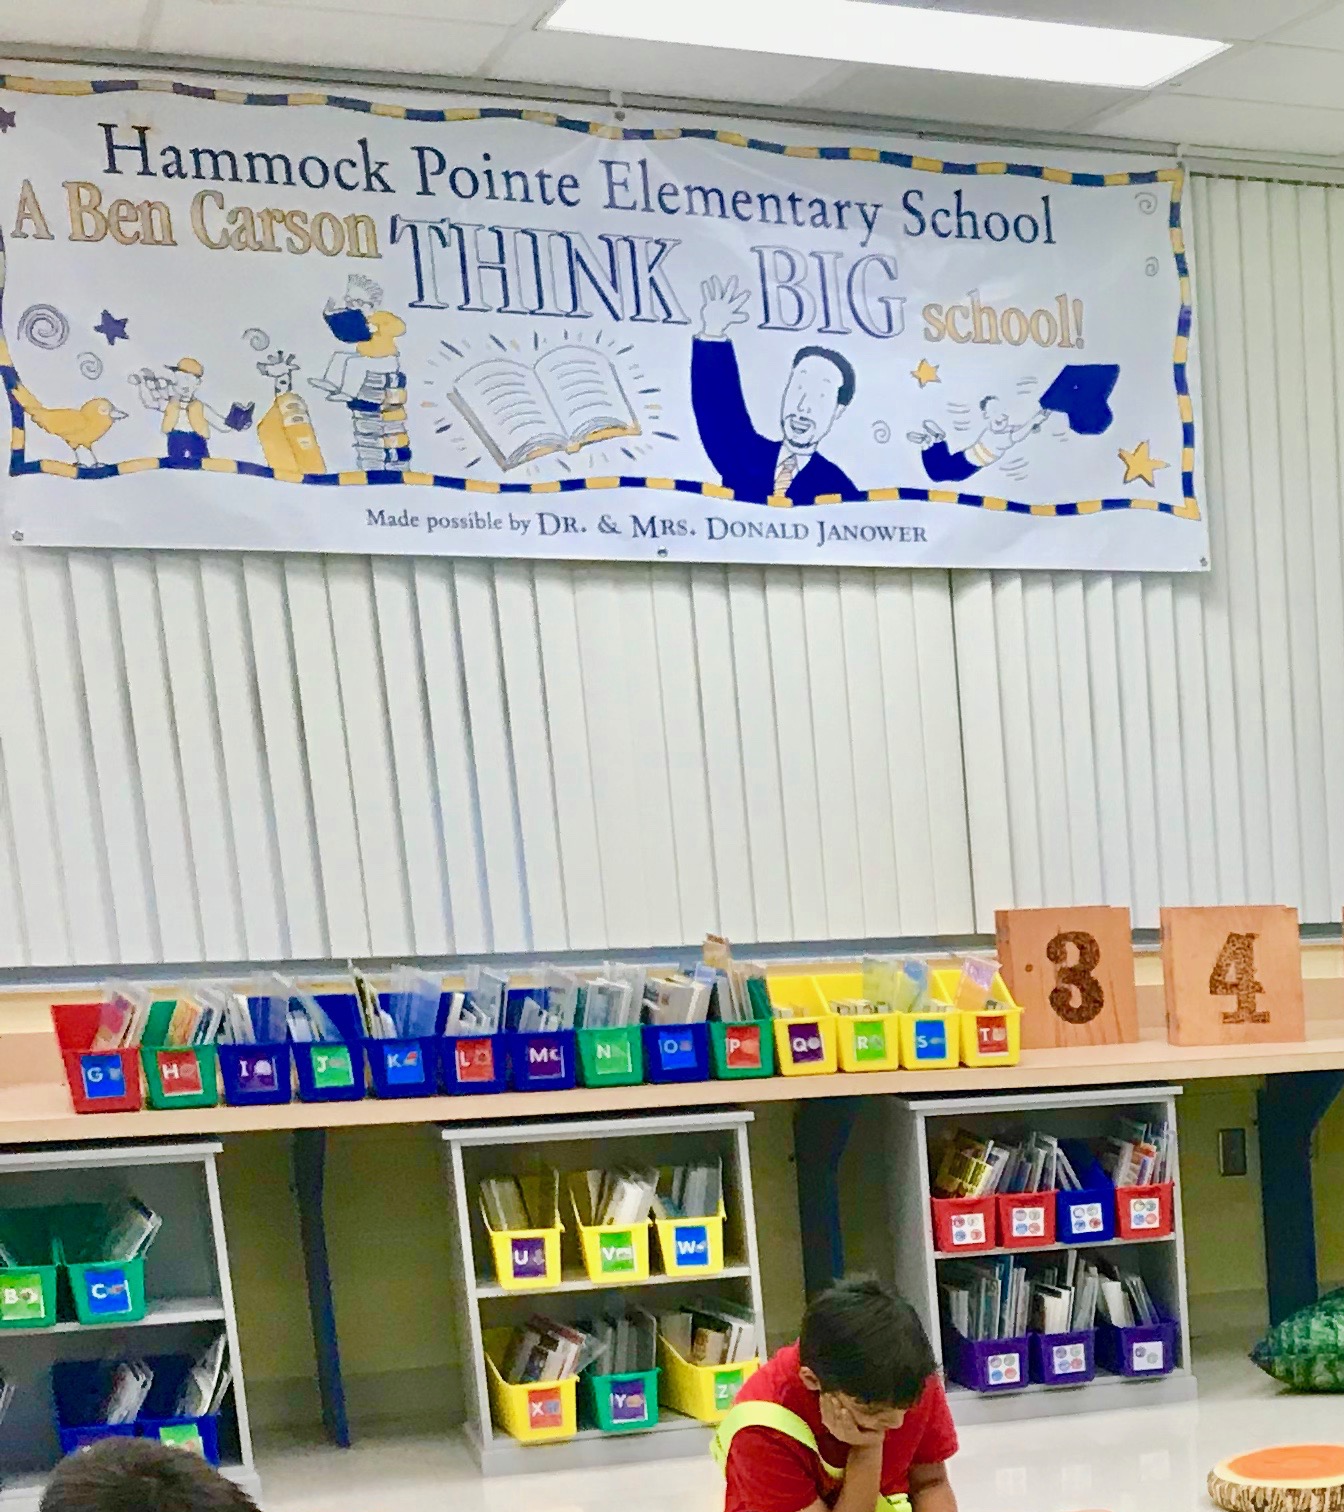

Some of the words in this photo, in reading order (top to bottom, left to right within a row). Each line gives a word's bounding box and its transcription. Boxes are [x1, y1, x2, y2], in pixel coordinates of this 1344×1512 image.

[98, 121, 397, 195] Hammock
[410, 145, 581, 208] Pointe
[599, 158, 883, 247] Elementary
[902, 188, 1057, 246] School
[10, 179, 54, 242] A
[62, 179, 178, 249] Ben
[189, 188, 382, 260] Carson
[390, 214, 693, 327] THINK
[750, 244, 907, 340] BIG
[922, 289, 1086, 350] school!
[365, 508, 420, 532] Made
[426, 509, 503, 535] possible
[509, 512, 532, 540] by
[597, 513, 619, 537] &
[1046, 929, 1104, 1024] 3
[1209, 932, 1271, 1024] 4
[857, 1034, 869, 1050] R
[916, 1034, 928, 1049] S
[980, 1027, 993, 1042] T
[596, 1044, 611, 1059] N
[664, 1039, 678, 1054] O
[729, 1037, 741, 1053] P
[792, 1036, 809, 1053] Q
[317, 1056, 328, 1074] J
[387, 1052, 402, 1069] K
[460, 1051, 470, 1068] L
[87, 1066, 103, 1082] G
[162, 1062, 180, 1080] H
[602, 1247, 616, 1261] V
[677, 1240, 697, 1254] W
[513, 1250, 529, 1265] U
[4, 1288, 18, 1304] B
[92, 1283, 107, 1299] C
[717, 1384, 729, 1399] Z
[531, 1402, 544, 1417] X
[615, 1394, 626, 1409] Y
